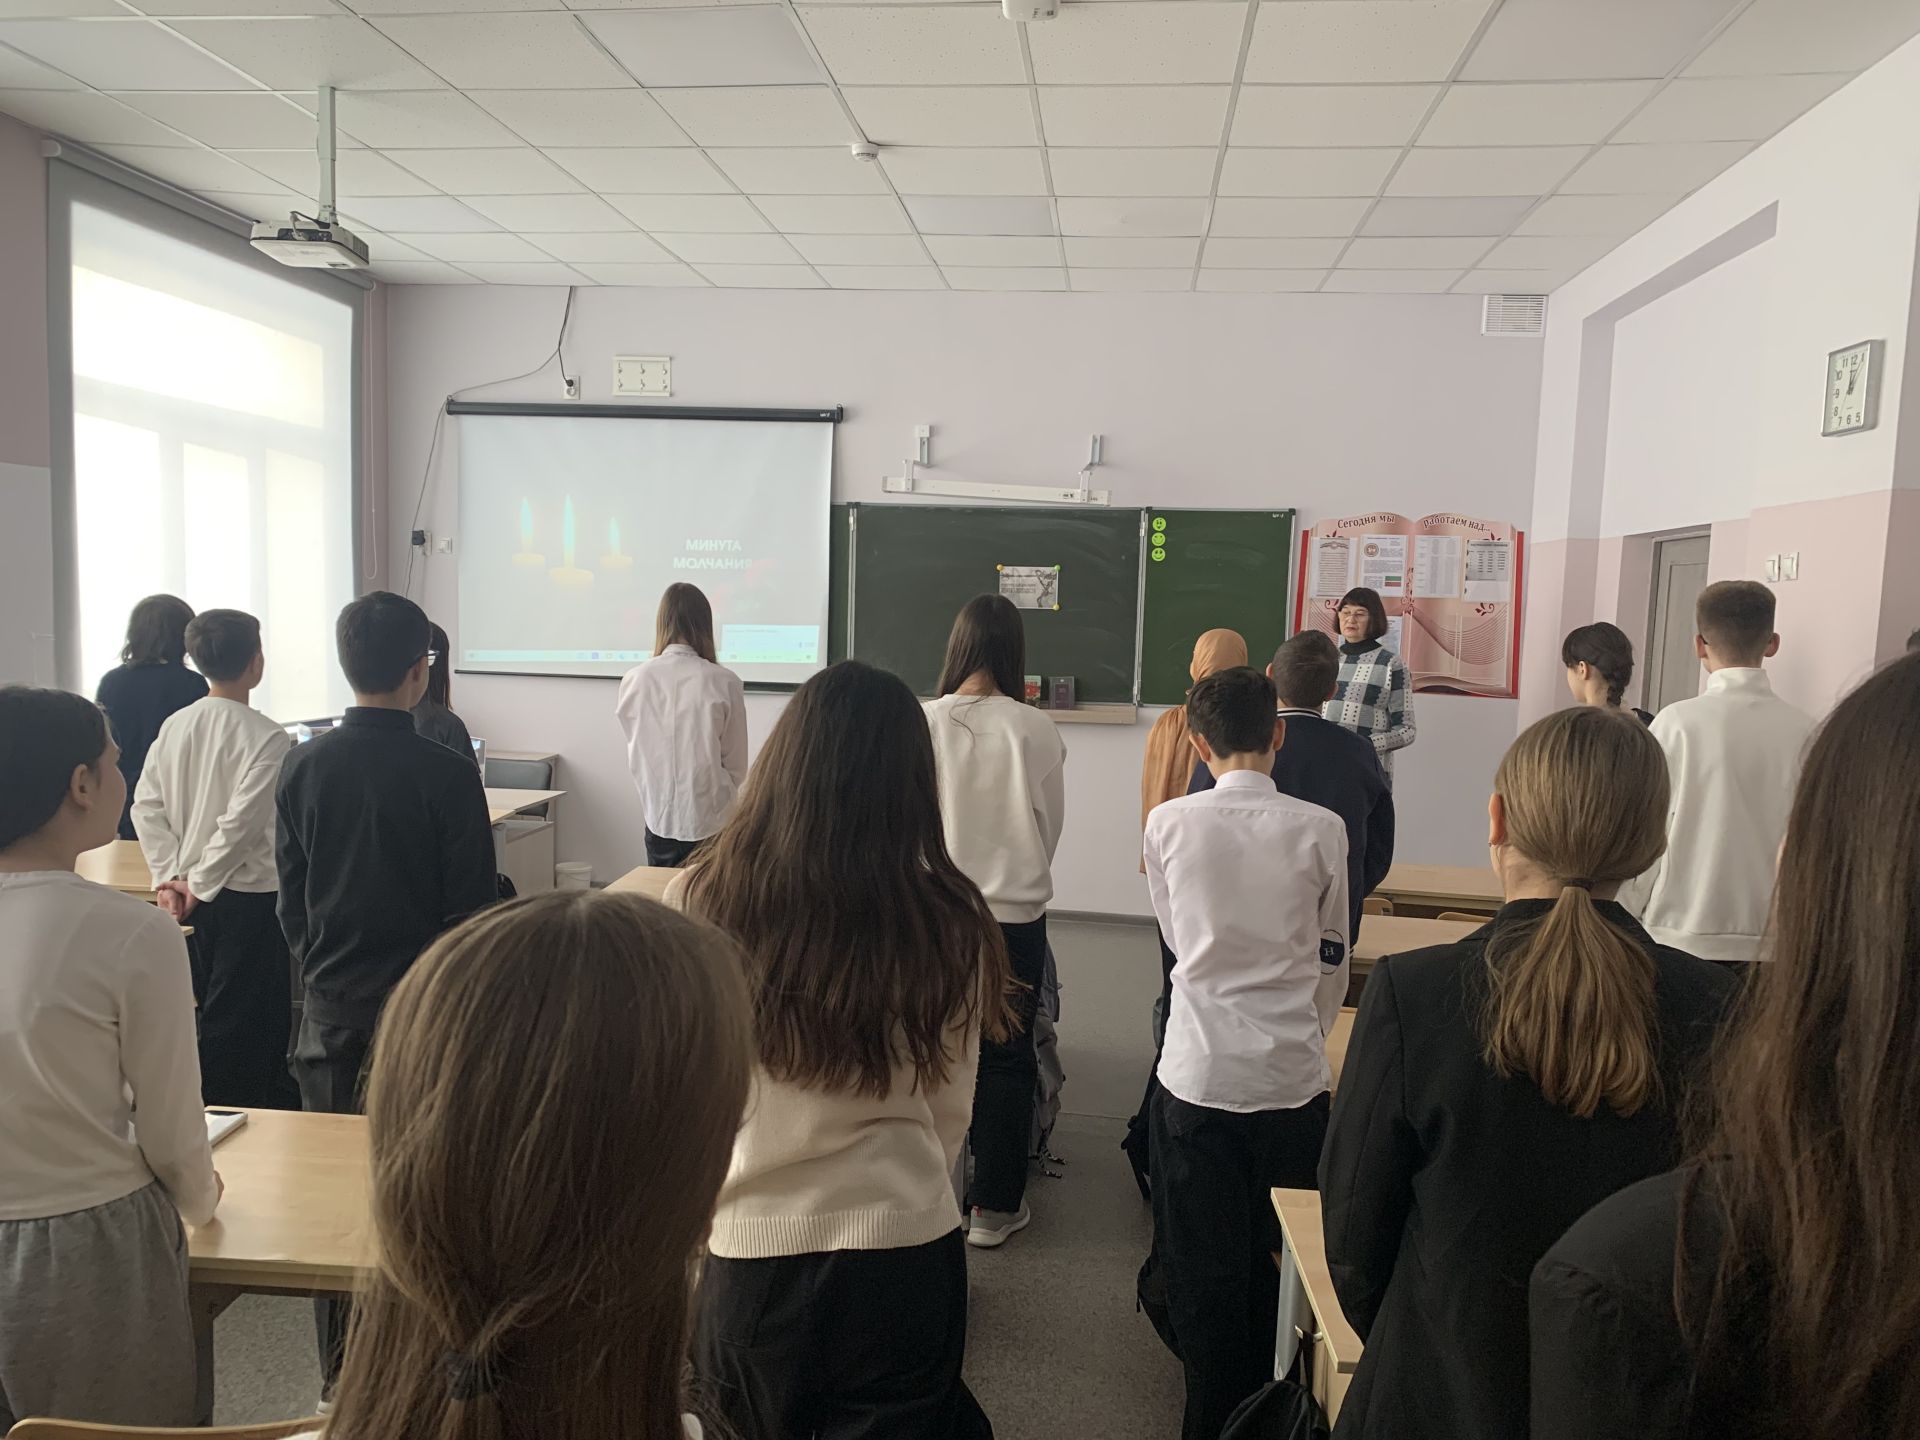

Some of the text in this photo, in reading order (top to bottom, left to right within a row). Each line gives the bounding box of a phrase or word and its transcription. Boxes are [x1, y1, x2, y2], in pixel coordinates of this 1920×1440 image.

[1337, 514, 1377, 529] Сегодня
[1380, 514, 1395, 523] мы
[1423, 515, 1467, 529] работаем
[685, 539, 742, 551] МИНУТА
[673, 557, 753, 570] МОЛЧАНИЯ
